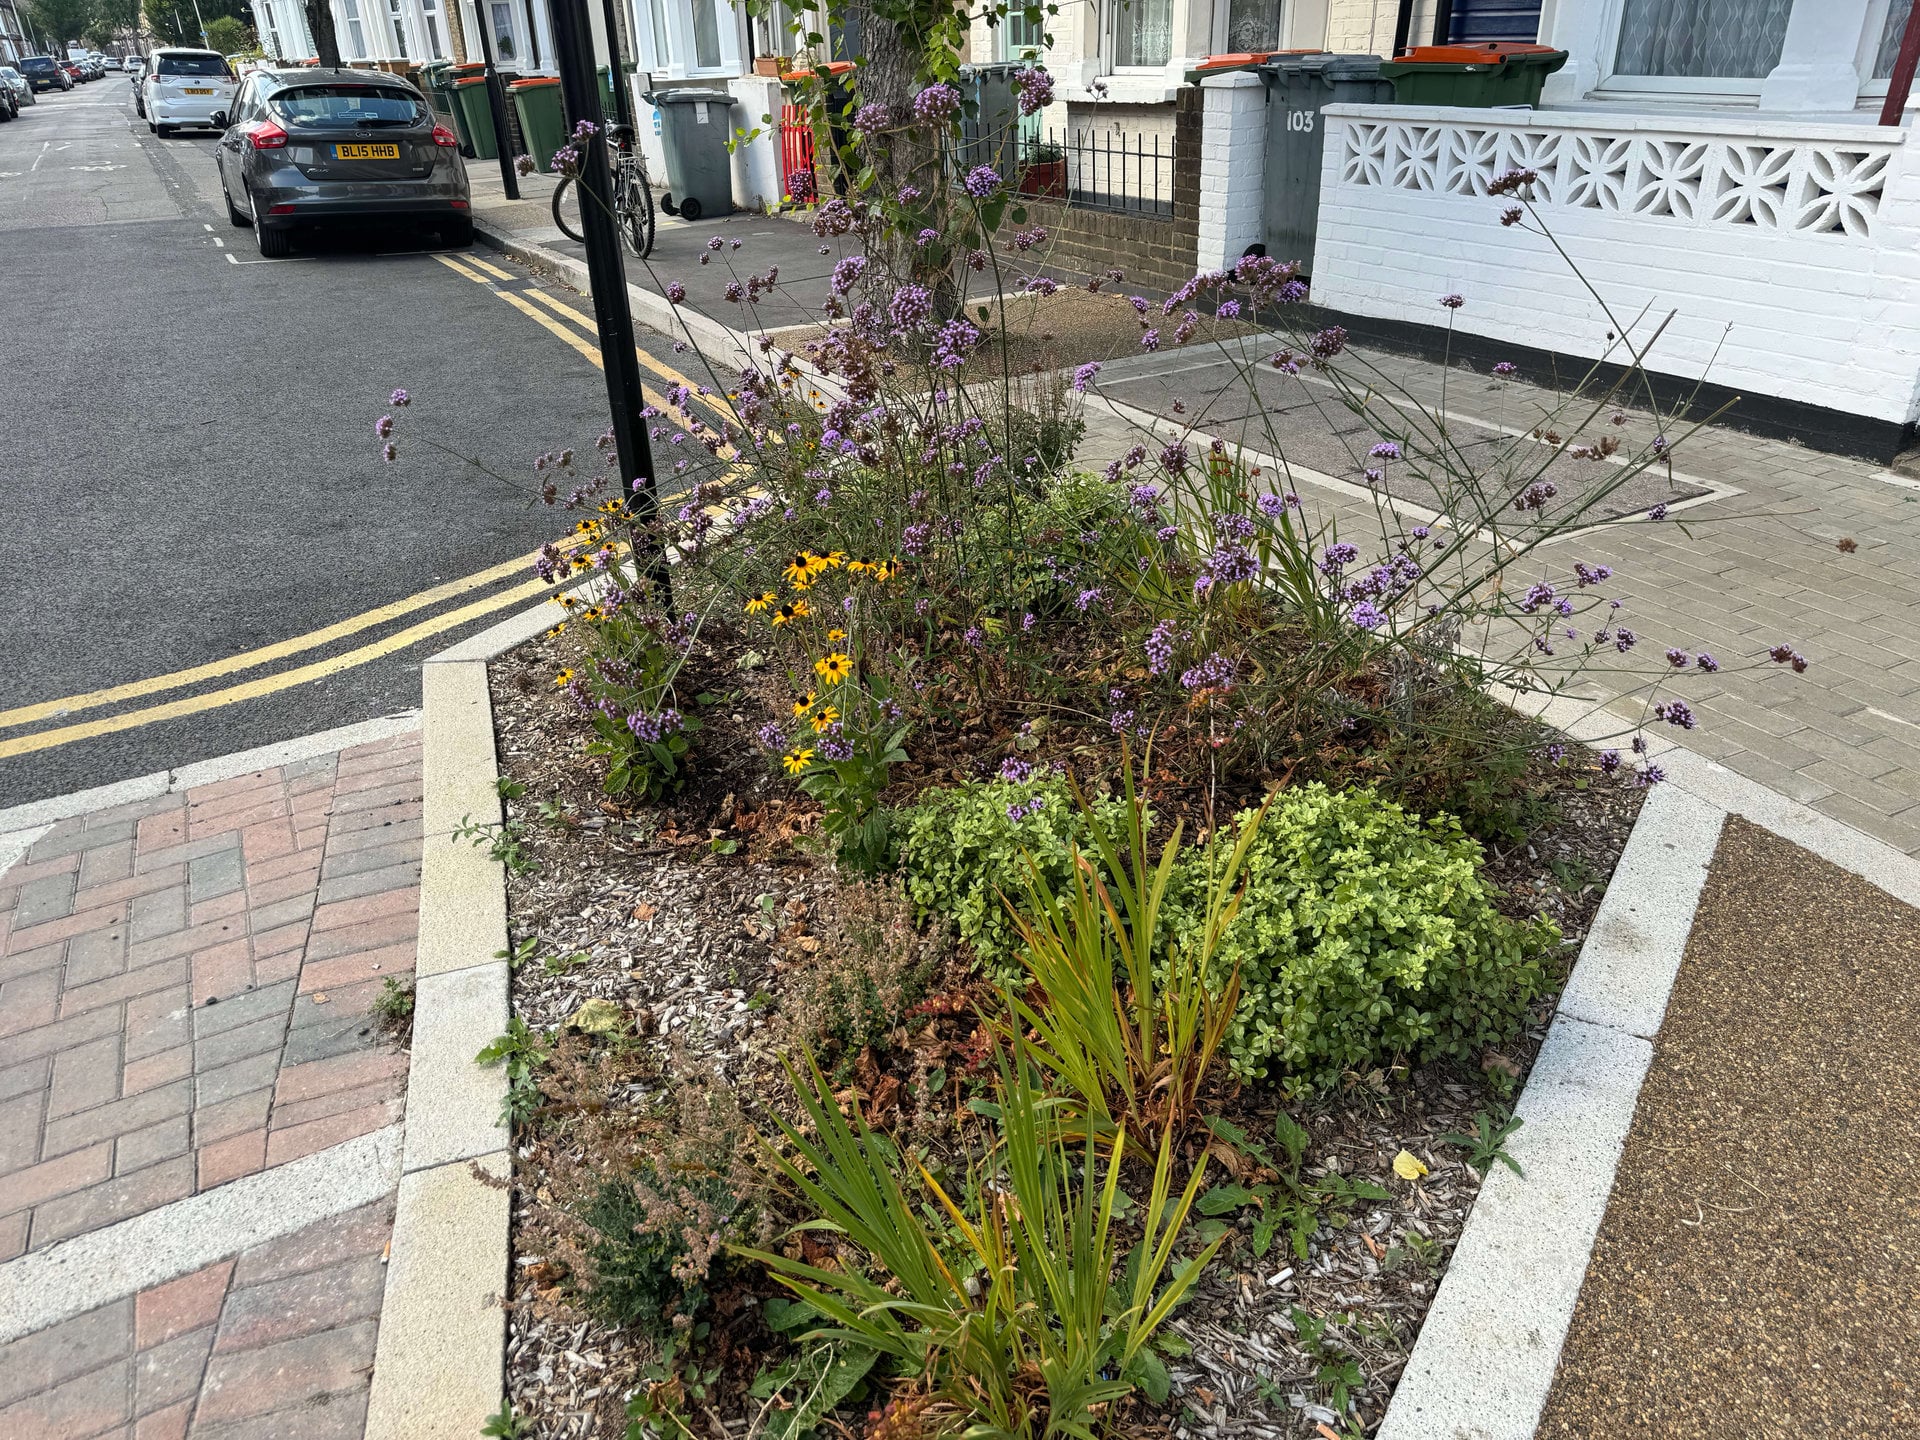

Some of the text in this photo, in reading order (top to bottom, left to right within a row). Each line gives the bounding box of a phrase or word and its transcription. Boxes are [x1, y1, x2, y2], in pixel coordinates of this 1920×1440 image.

[1287, 110, 1315, 133] 103
[341, 145, 369, 157] BL15
[371, 145, 395, 157] HHB
